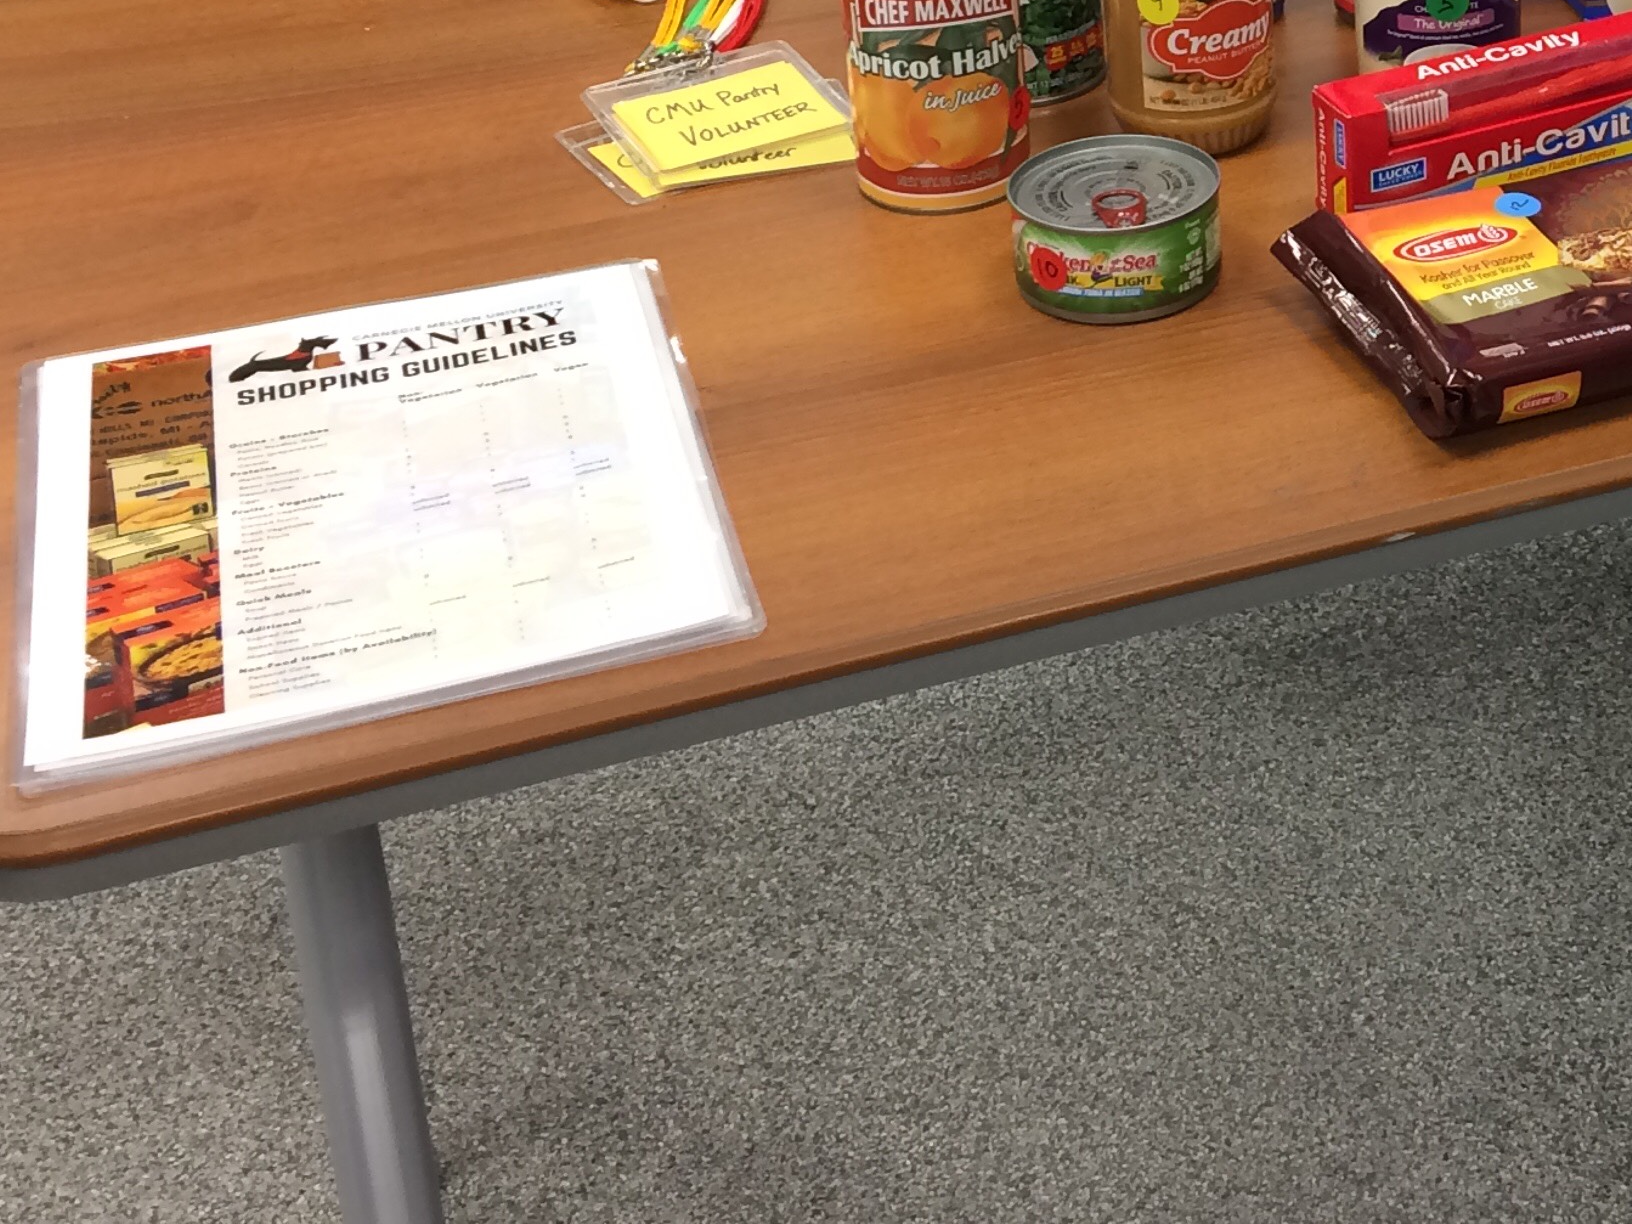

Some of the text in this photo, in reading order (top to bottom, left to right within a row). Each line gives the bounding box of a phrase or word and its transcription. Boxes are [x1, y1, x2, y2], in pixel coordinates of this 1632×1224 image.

[1167, 10, 1270, 55] Creamy
[1413, 17, 1436, 30] The
[849, 39, 943, 80] Apricot
[1187, 50, 1229, 64] PEANUT
[1417, 29, 1582, 80] Anti-Cavity
[645, 83, 780, 125] CMU Pantry
[924, 90, 947, 110] in
[947, 82, 1001, 113] Juice
[678, 101, 818, 147] VOLUNTEER
[1378, 162, 1420, 182] LUCKY
[1413, 232, 1478, 258] OSEM
[1123, 253, 1159, 271] Sea
[1419, 251, 1536, 284] Kosher for Passover
[1442, 260, 1531, 290] and All Year Round
[1115, 275, 1154, 287] LIGHT
[1462, 277, 1539, 307] MARBLE
[1494, 297, 1524, 310] CAKE
[351, 300, 563, 341] CARNEGIE MELLON UNIVERSITY
[357, 307, 565, 363] PANTRY
[237, 330, 577, 406] SHOPPING GUIDELINES
[237, 618, 303, 635] Additional
